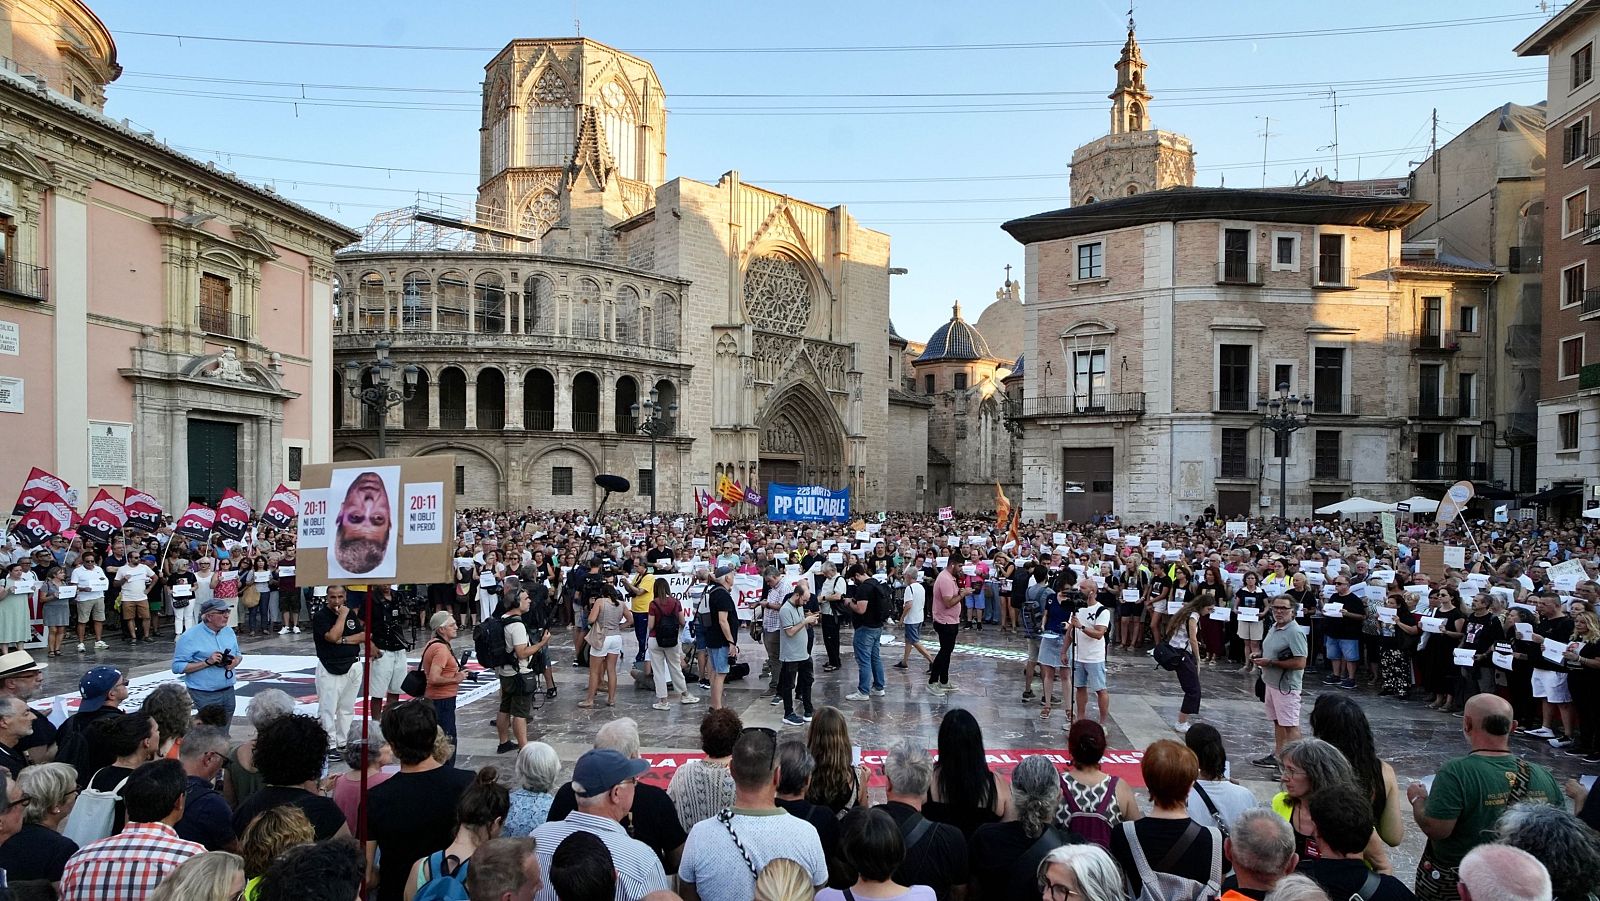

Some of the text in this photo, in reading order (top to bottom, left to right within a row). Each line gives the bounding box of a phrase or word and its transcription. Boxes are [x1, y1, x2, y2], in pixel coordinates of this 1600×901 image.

[304, 501, 326, 515] 20:11
[411, 495, 436, 510] 20:11
[774, 496, 846, 516] PP CULPABLE
[130, 510, 158, 522] CGT
[220, 514, 246, 530] CGT
[268, 506, 290, 524] CGT
[303, 517, 326, 526] NI OBLIT
[410, 512, 436, 521] NI OBLIT
[26, 518, 52, 540] CGT
[88, 516, 118, 534] CGT
[184, 520, 208, 532] CGT
[737, 588, 764, 607] ASE
[1098, 754, 1140, 764] AÍS
